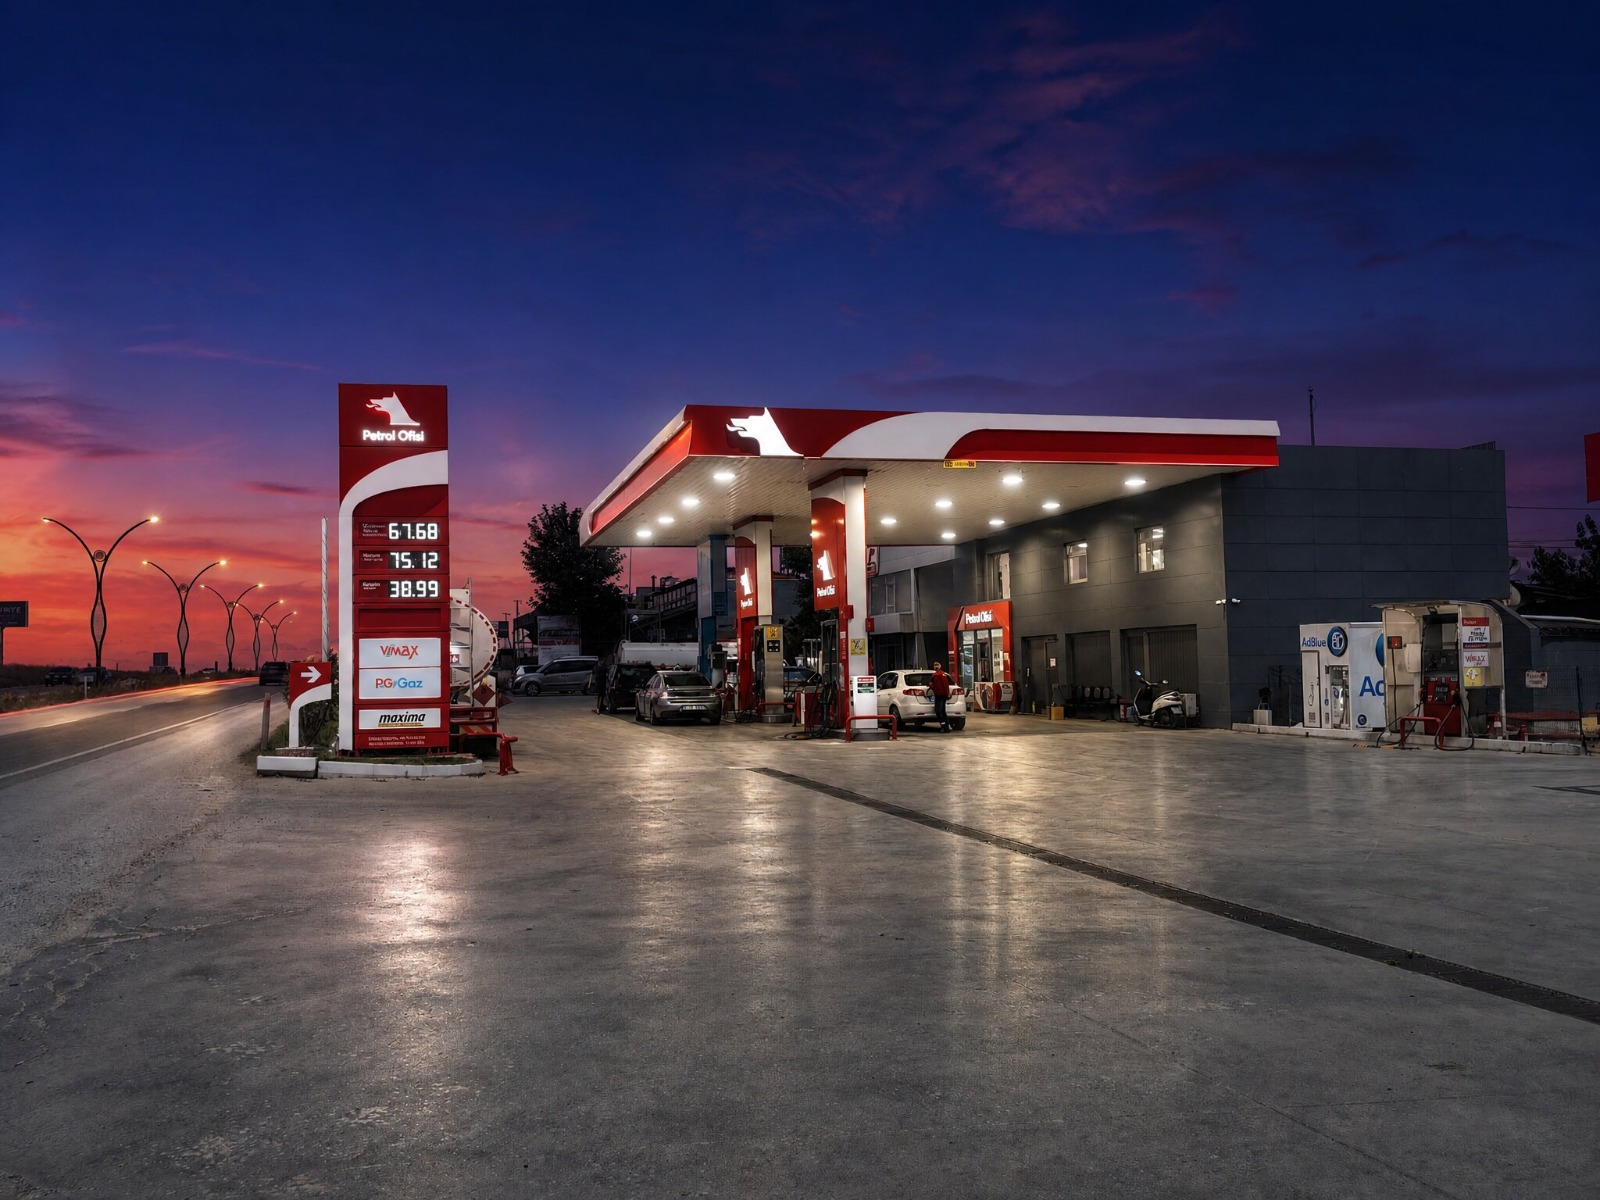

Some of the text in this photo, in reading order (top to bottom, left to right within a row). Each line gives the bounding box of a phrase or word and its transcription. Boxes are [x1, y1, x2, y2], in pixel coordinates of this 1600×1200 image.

[362, 429, 425, 442] Petrol Ofisi
[388, 522, 438, 540] 67.68
[389, 580, 439, 598] 38.99
[1301, 636, 1327, 648] AdBlue
[378, 711, 426, 723] maxima
